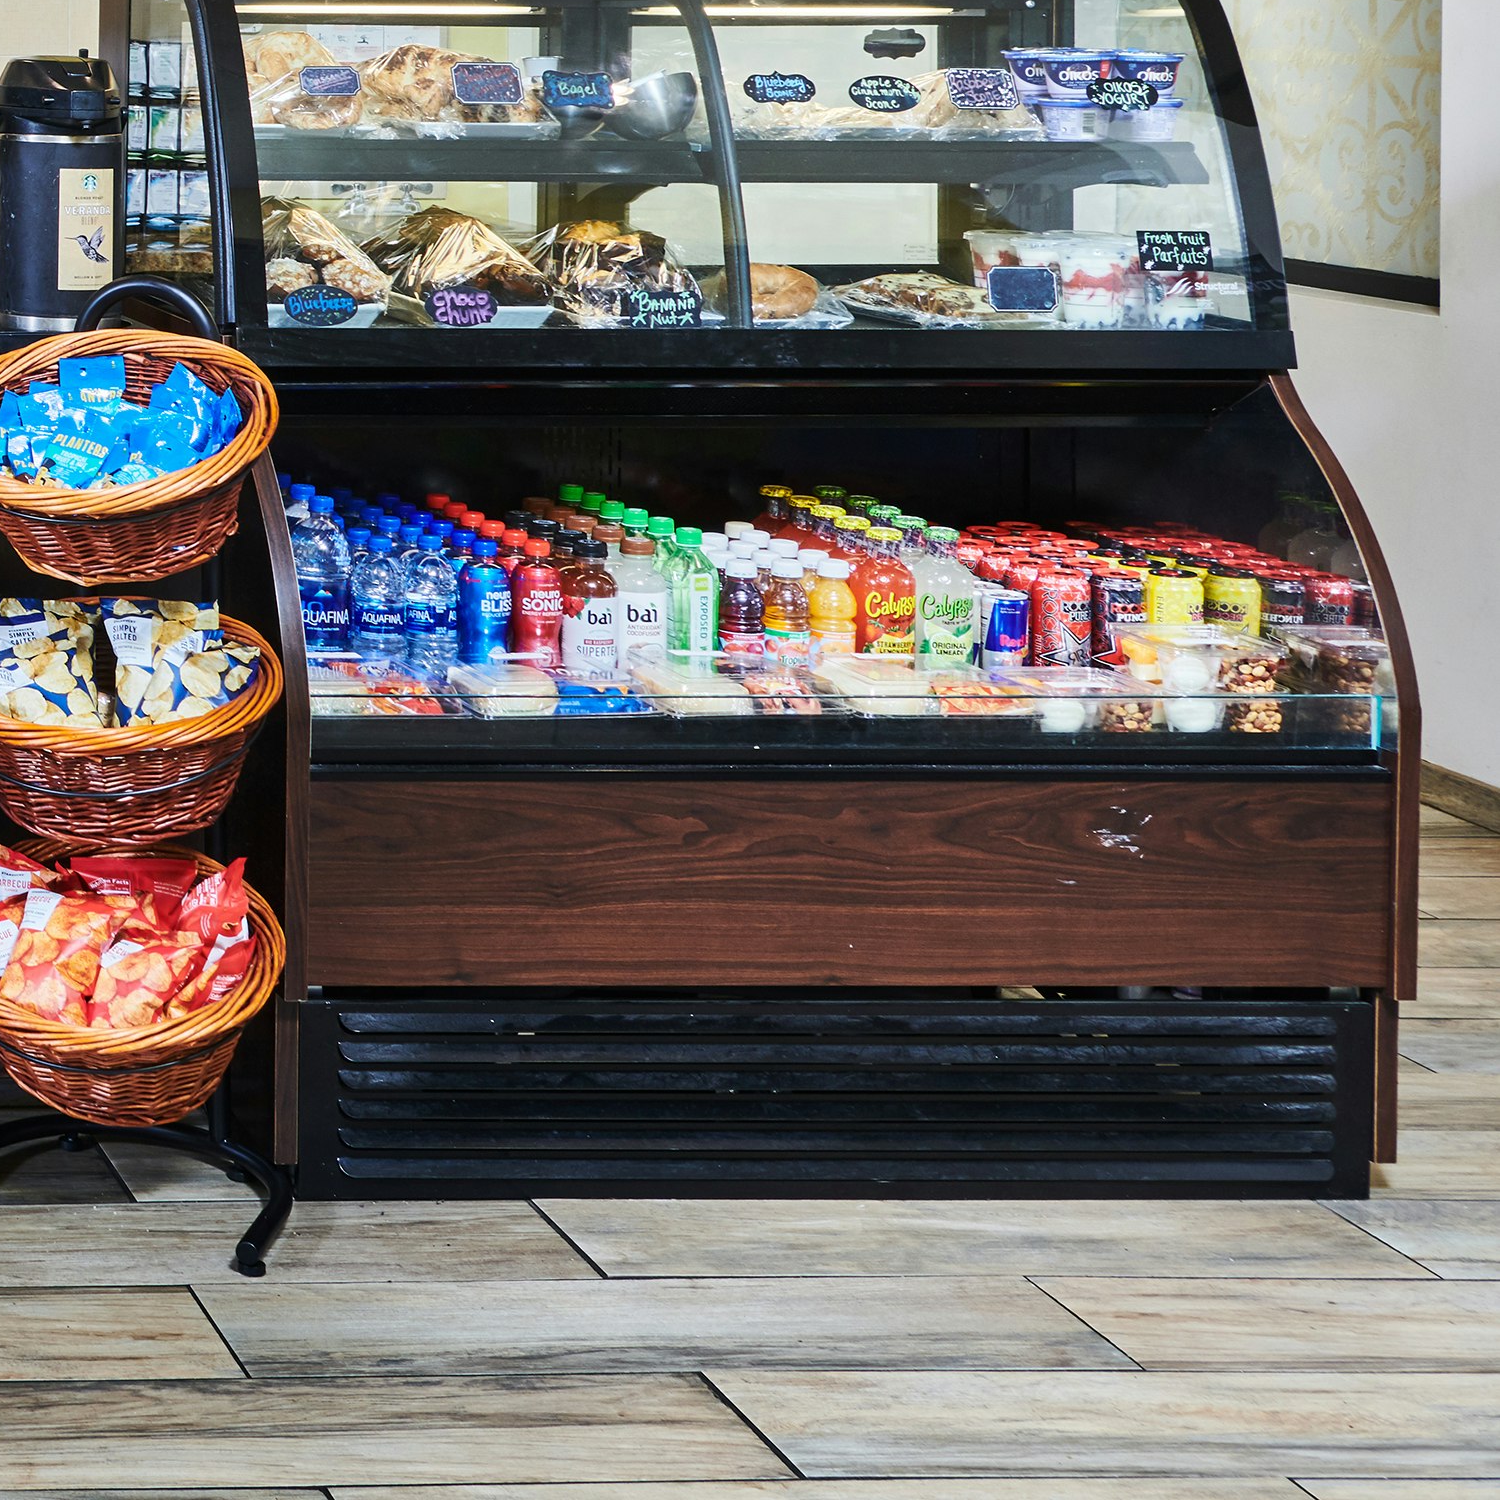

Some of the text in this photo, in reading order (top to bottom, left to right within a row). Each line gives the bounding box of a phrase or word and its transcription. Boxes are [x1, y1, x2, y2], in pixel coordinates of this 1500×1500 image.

[557, 82, 598, 97] Bagel
[1097, 89, 1151, 105] YOGURT
[64, 205, 112, 216] VERANDA
[1143, 232, 1206, 245] Fresh Fruit
[1152, 247, 1208, 266] Parfaits
[1194, 282, 1238, 291] Structural
[52, 433, 110, 460] PLANTERS
[530, 590, 561, 601] neuro
[522, 598, 565, 613] SONIC
[864, 591, 916, 619] Calyps
[588, 608, 613, 625] bai
[627, 602, 658, 623] bai
[700, 595, 710, 640] EXPOSED
[8, 630, 36, 639] SIMPLY
[112, 624, 138, 634] SIMPLY
[112, 632, 138, 642] SALTED
[931, 641, 967, 650] ORIGINAL
[935, 649, 965, 657] LIMEADE
